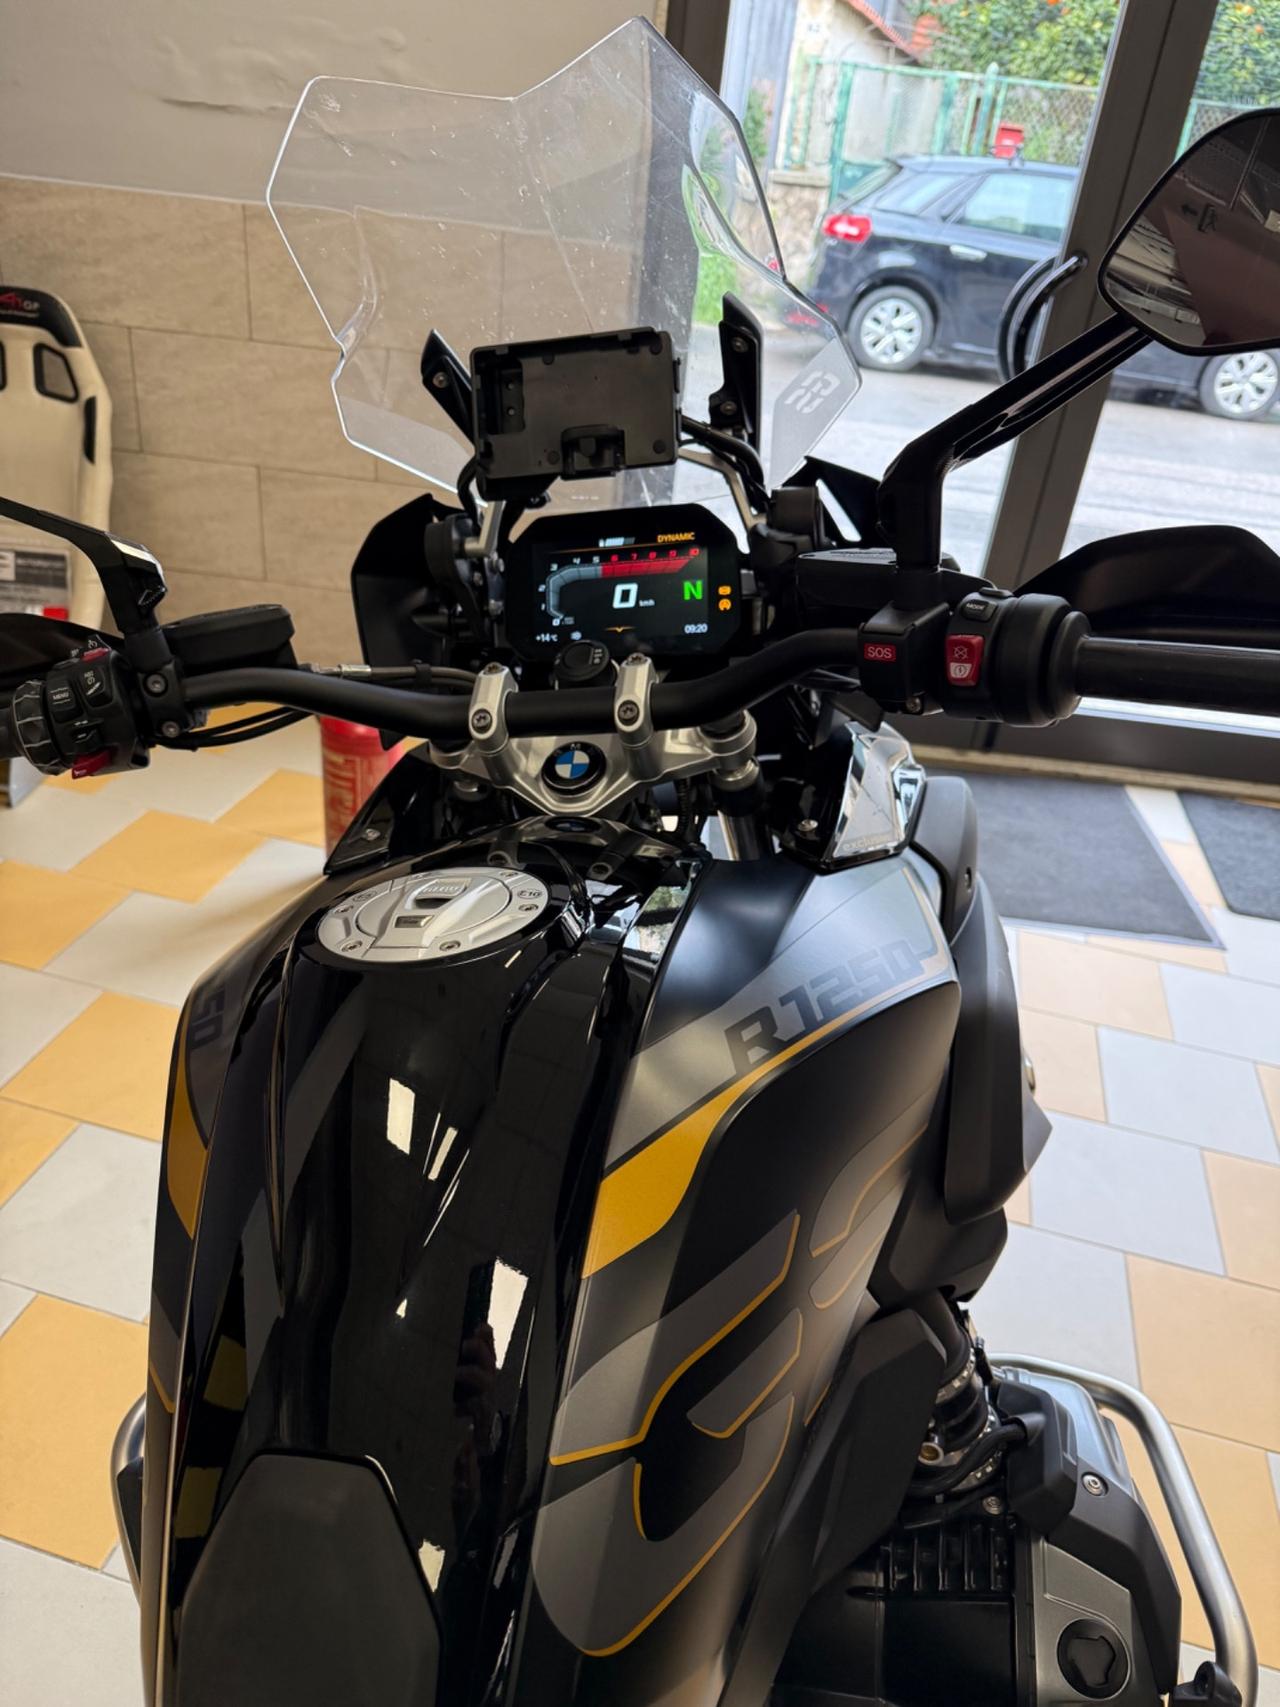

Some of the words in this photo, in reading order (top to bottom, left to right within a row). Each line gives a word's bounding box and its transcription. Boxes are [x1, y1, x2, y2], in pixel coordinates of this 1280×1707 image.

[657, 532, 696, 543] DYNAMIC
[612, 583, 638, 609] 0
[683, 580, 703, 600] N
[684, 623, 708, 634] 09:20
[867, 646, 892, 659] SOS
